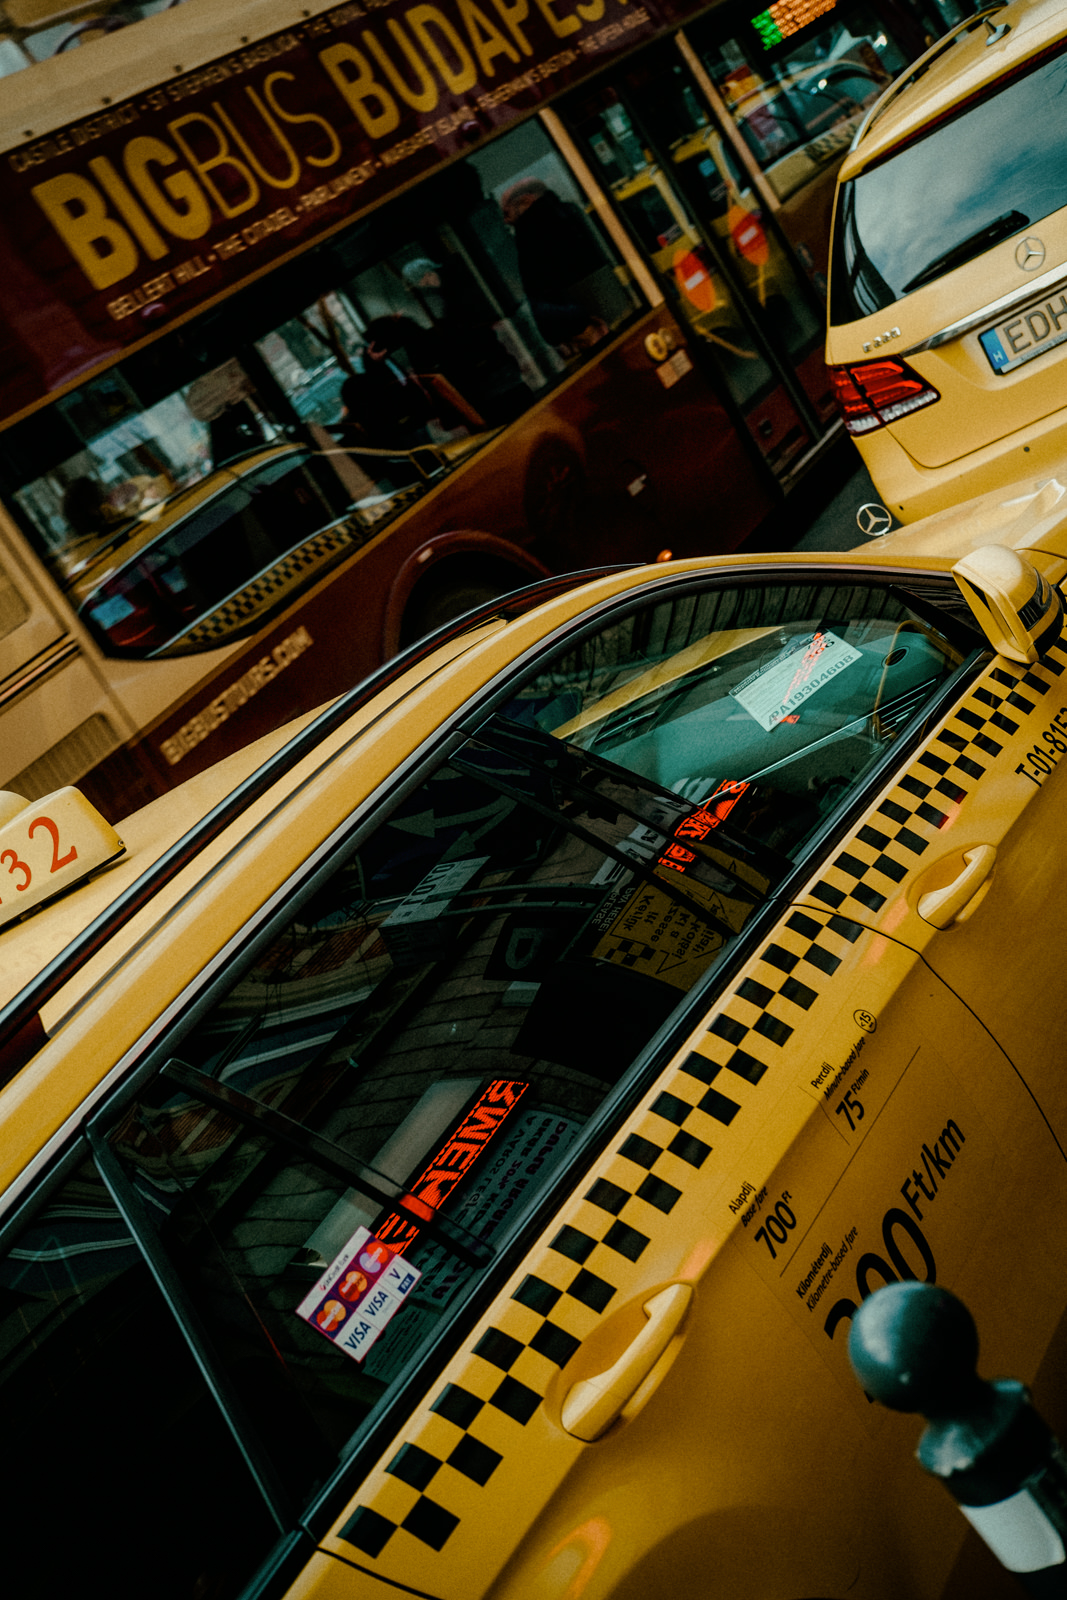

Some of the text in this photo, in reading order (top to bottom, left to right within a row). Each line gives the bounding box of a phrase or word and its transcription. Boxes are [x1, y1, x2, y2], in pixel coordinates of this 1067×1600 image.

[70, 103, 136, 146] DISTRICT
[174, 256, 211, 283] HILL
[212, 233, 247, 260] THE
[242, 207, 299, 245] CITADEL
[300, 160, 374, 211] PARLIAMENT
[380, 123, 440, 167] MARGARET
[536, 49, 577, 79] BASTION
[900, 1117, 966, 1222] Ft/km
[741, 1186, 768, 1228] Base fare
[842, 1226, 858, 1250] fare
[344, 1321, 371, 1349] VISA
[364, 1291, 388, 1316] VISA
